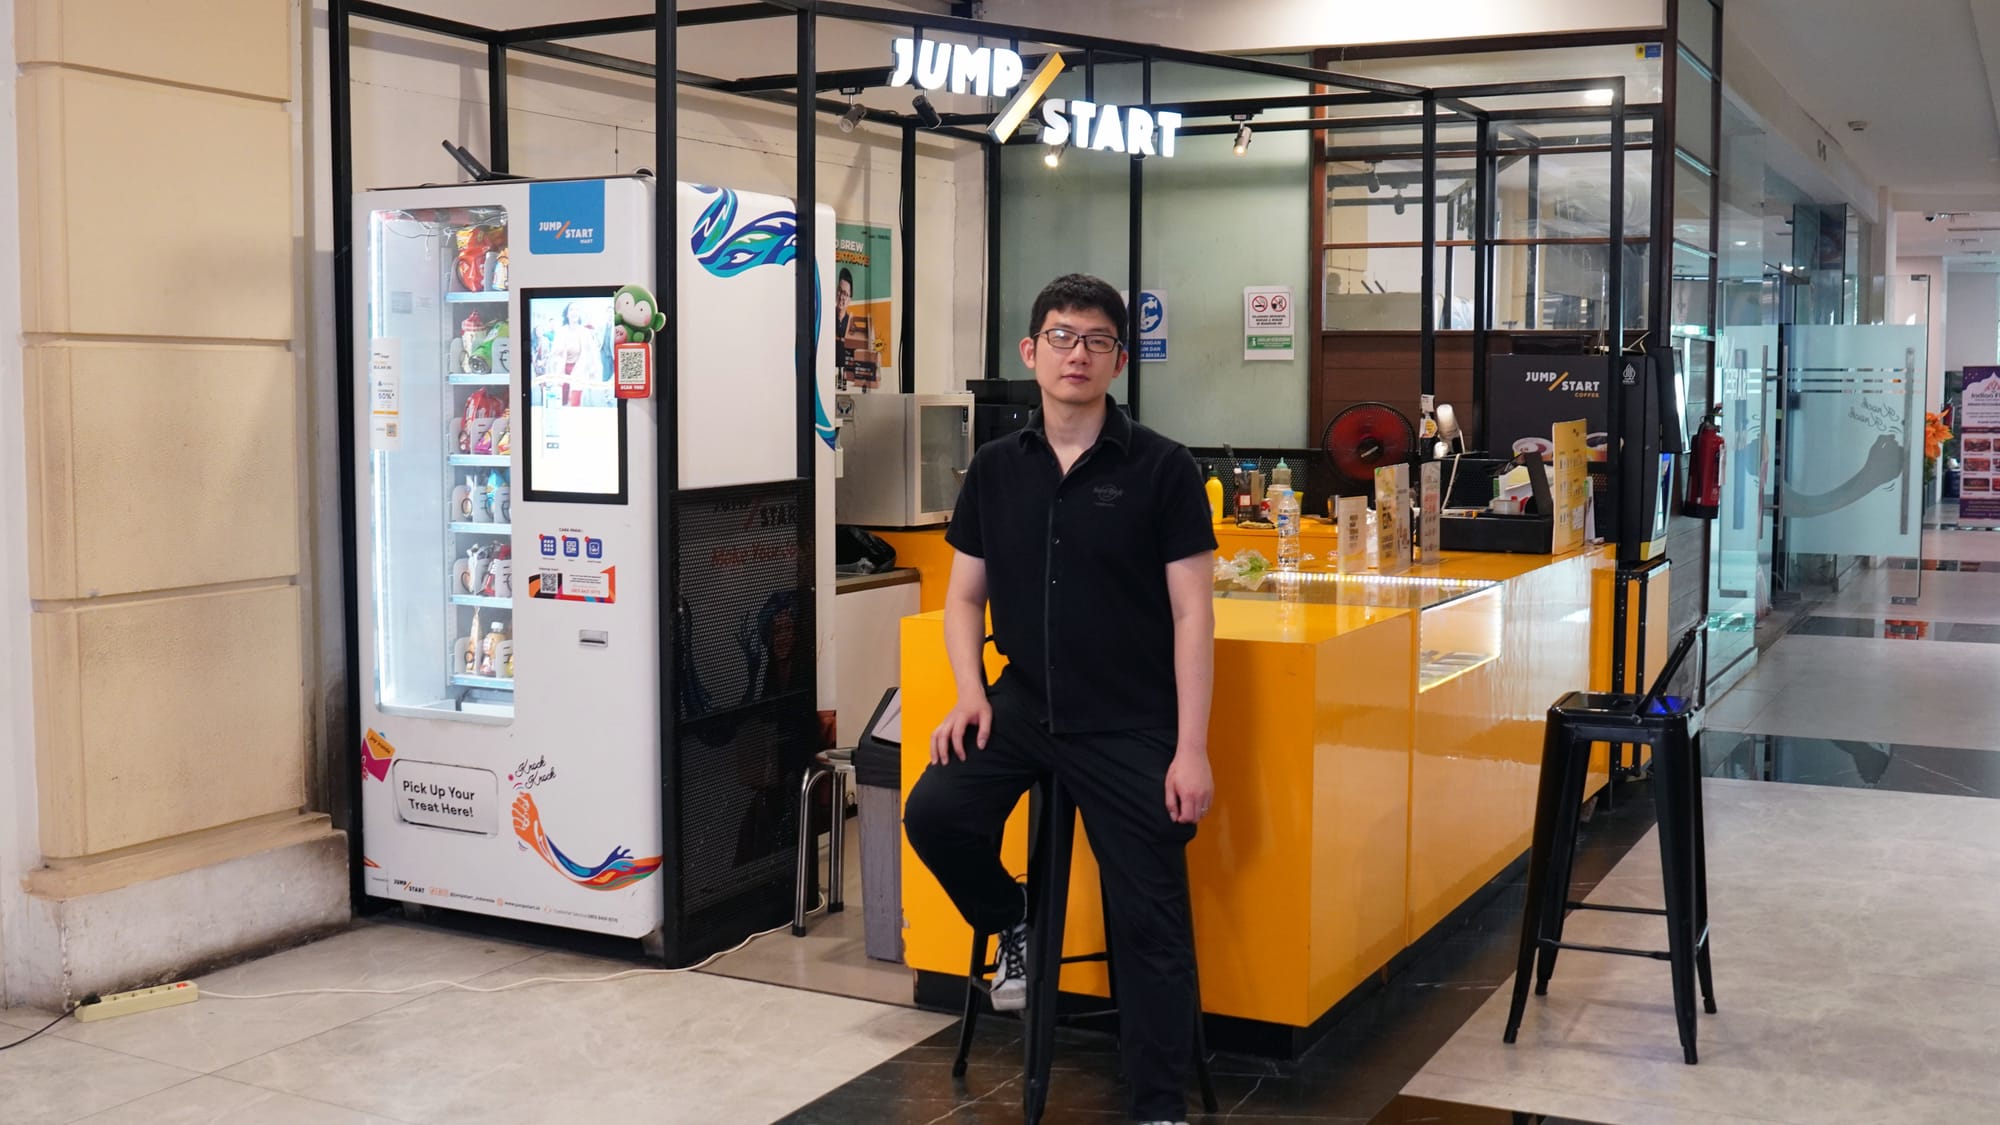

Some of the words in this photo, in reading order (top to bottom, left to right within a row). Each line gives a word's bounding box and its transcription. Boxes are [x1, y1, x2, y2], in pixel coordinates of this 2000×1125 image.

[891, 37, 1023, 97] JUMP
[1041, 98, 1183, 158] START
[539, 221, 562, 231] JUMP
[565, 228, 594, 239] START
[840, 240, 864, 252] BREW
[1525, 371, 1557, 382] JUMP
[1561, 381, 1600, 392] START
[403, 780, 427, 794] Pick
[430, 784, 446, 799] Up
[448, 786, 475, 800] Your
[408, 798, 439, 813] Treat
[441, 803, 474, 817] Here!
